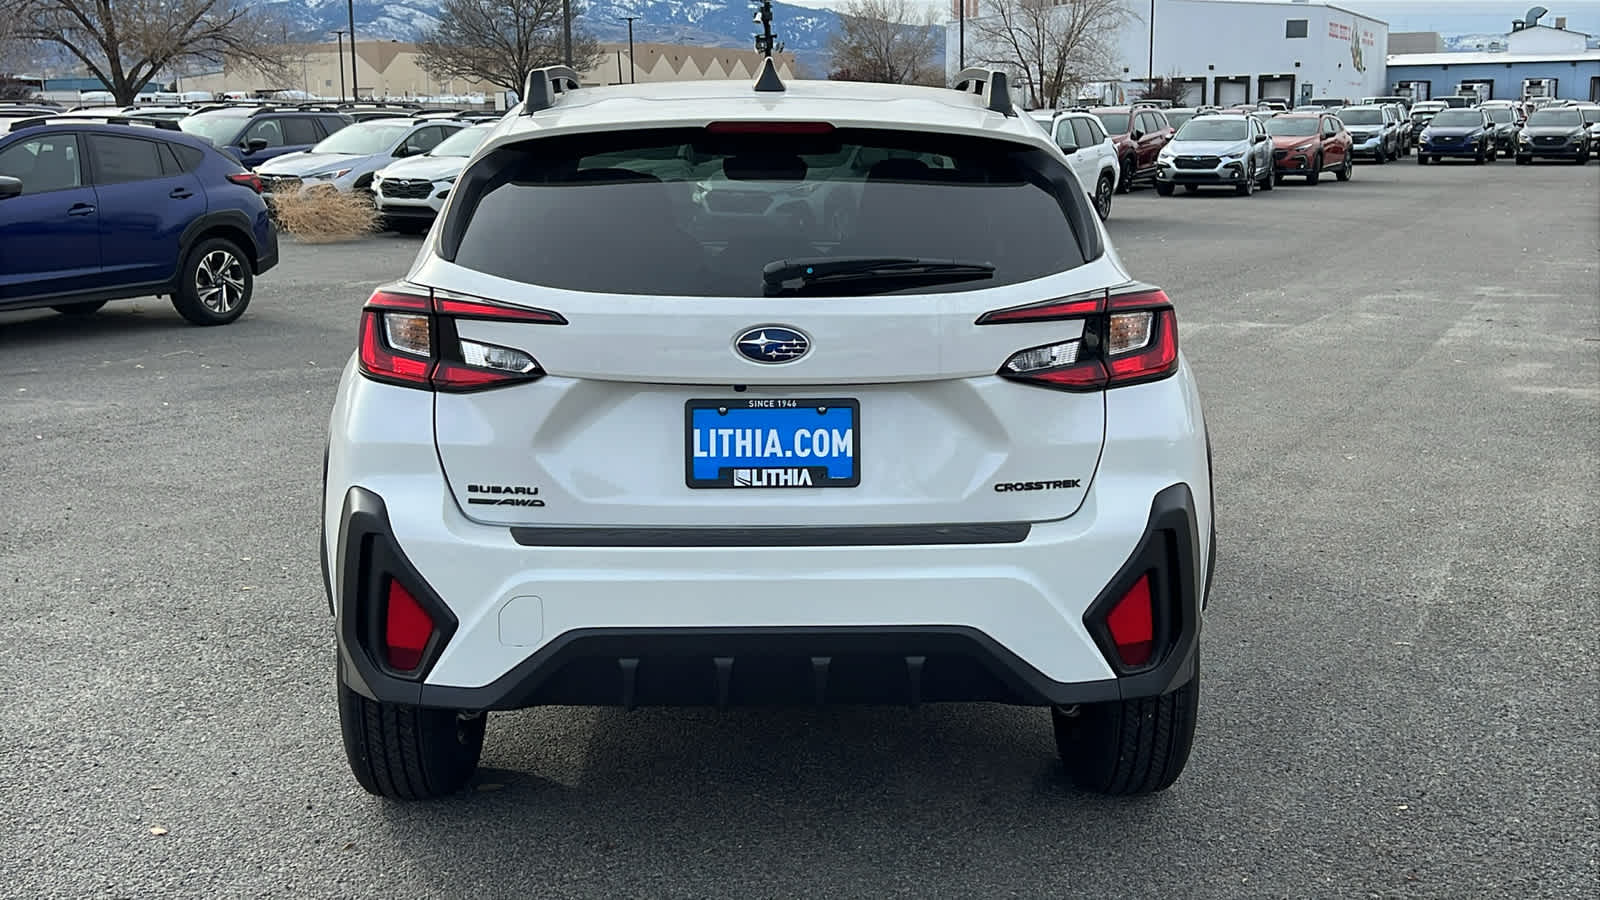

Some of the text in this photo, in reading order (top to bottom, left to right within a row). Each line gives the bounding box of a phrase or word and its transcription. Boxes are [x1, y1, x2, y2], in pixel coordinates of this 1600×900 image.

[748, 399, 797, 408] SINCE 1946
[693, 428, 853, 458] LITHIA.COM
[751, 468, 813, 486] LITHIA
[467, 484, 539, 496] SUBARU
[994, 479, 1081, 493] CROSSTREK
[497, 498, 546, 507] AWD
